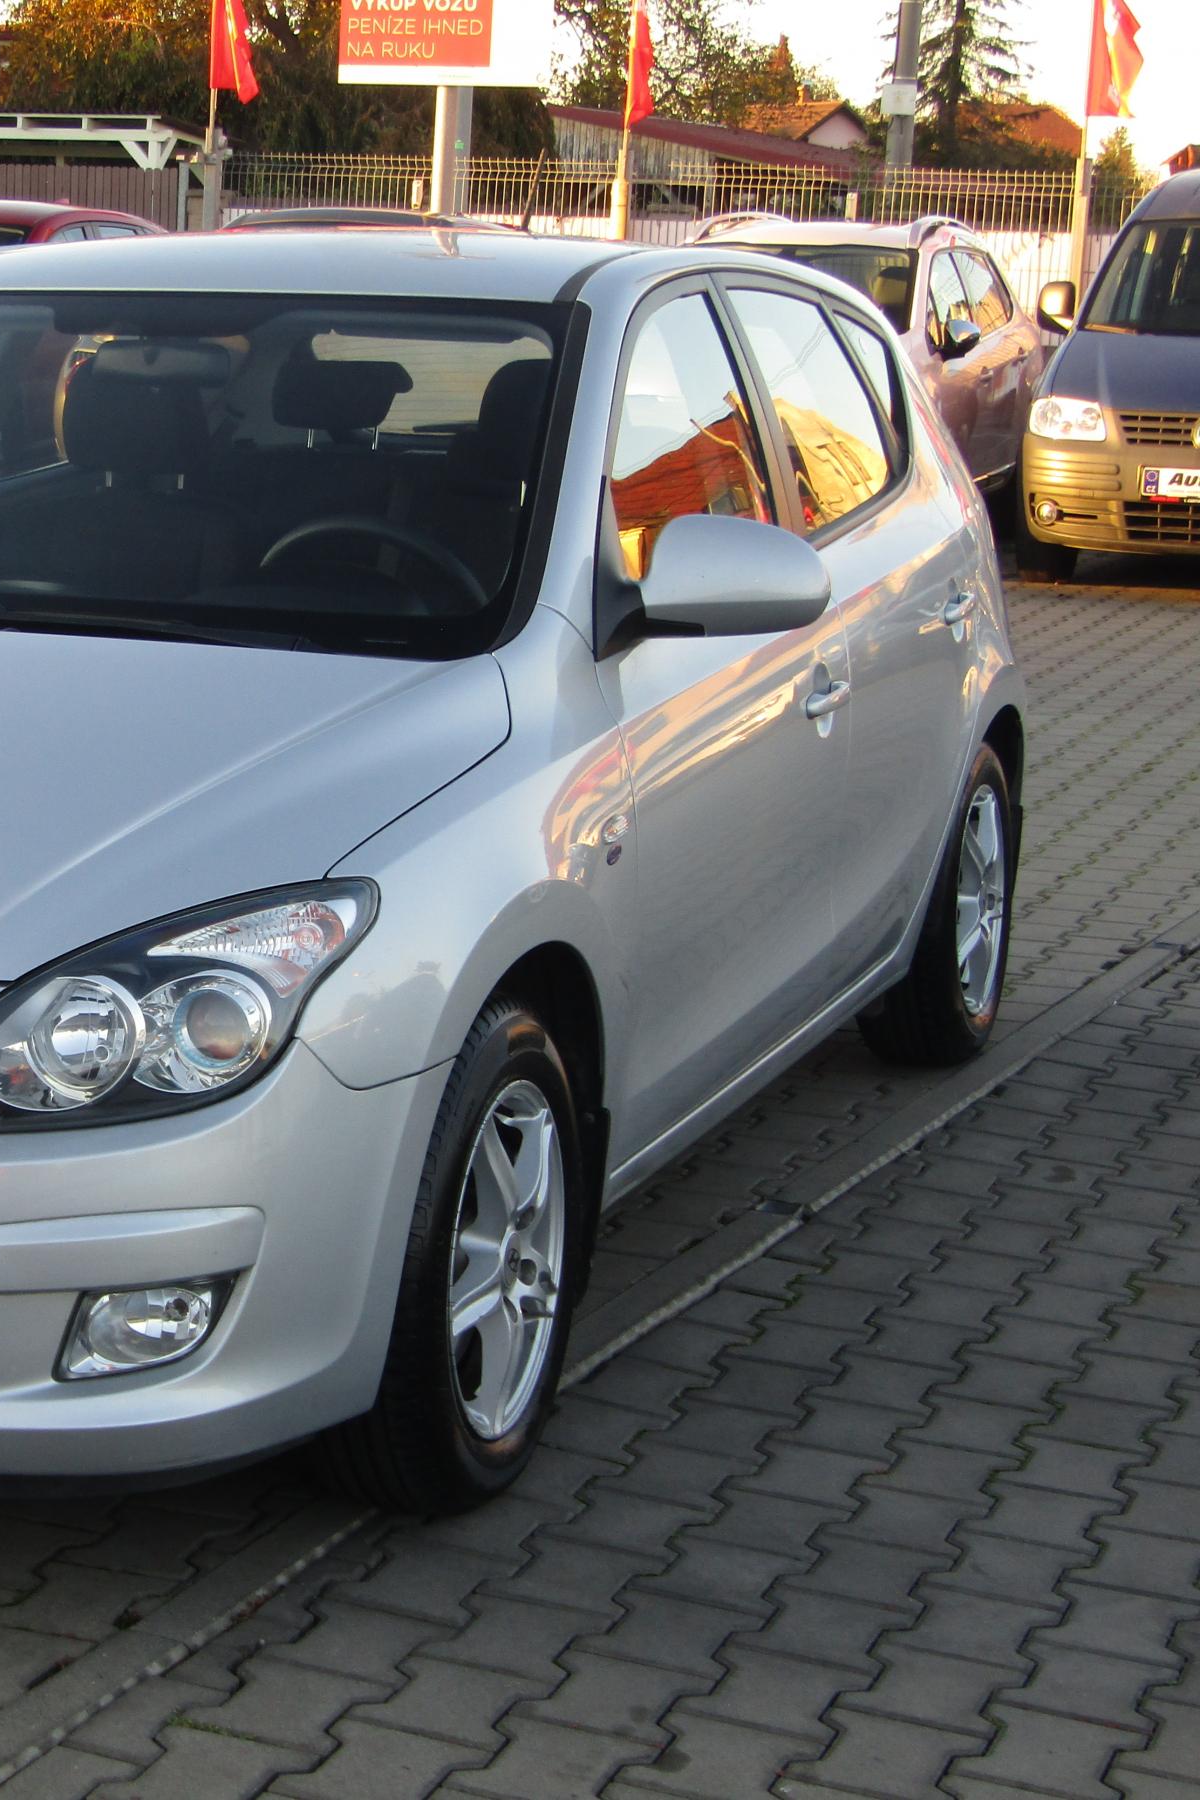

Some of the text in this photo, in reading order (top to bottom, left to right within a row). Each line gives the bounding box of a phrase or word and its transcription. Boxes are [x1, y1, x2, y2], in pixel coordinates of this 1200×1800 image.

[348, 15, 484, 36] PENÍZE IHNED
[347, 41, 435, 58] NA RUKU
[1145, 485, 1156, 493] CZ
